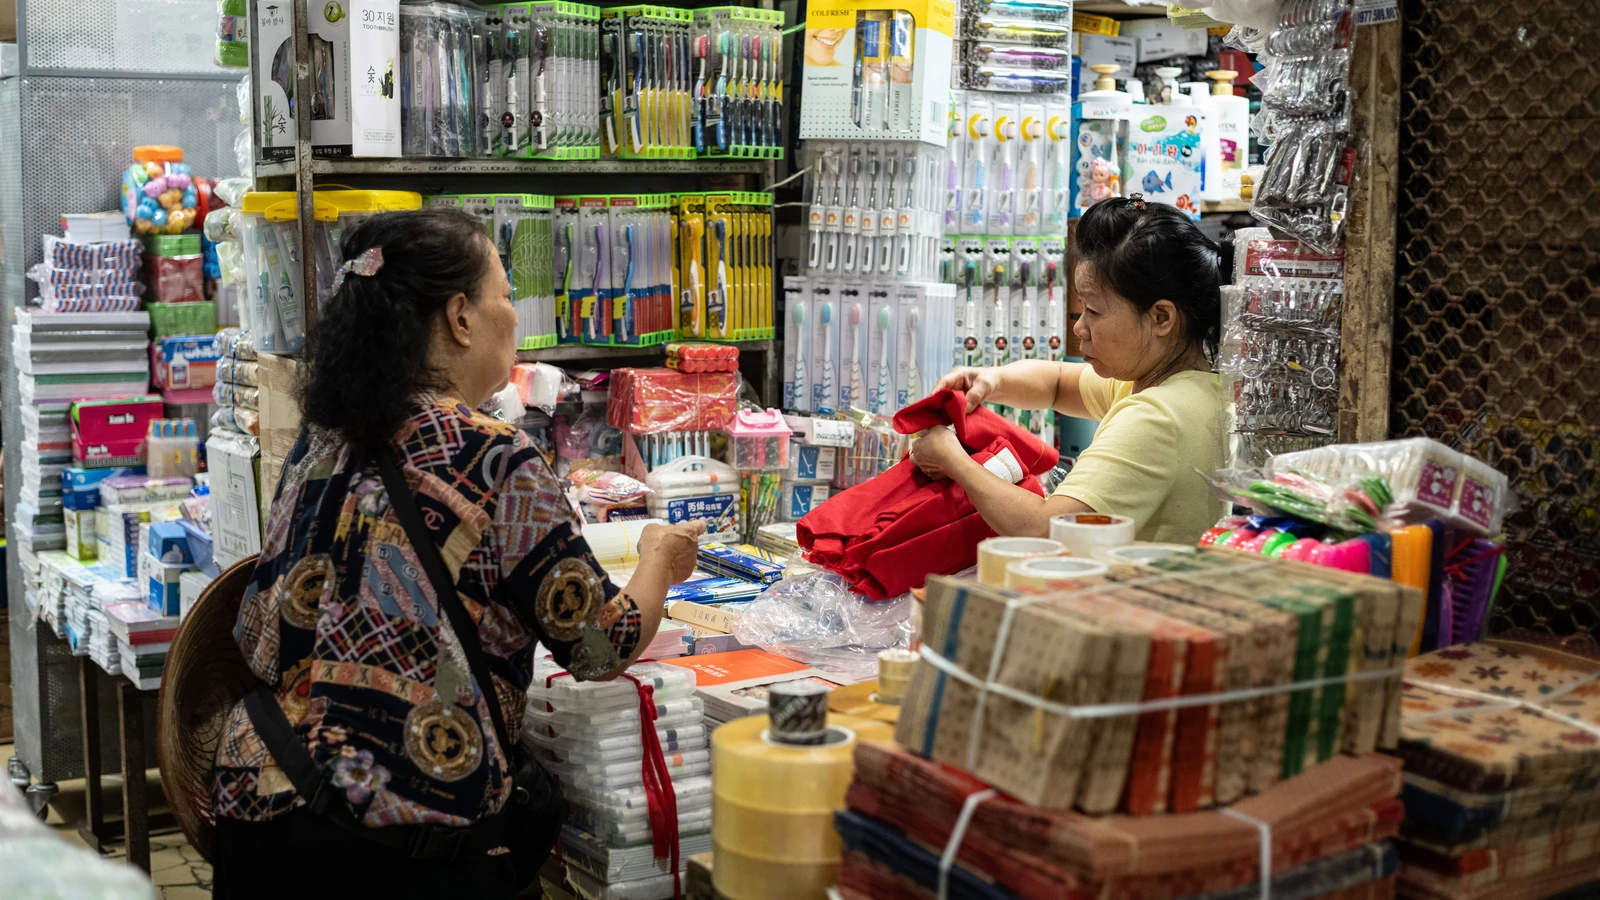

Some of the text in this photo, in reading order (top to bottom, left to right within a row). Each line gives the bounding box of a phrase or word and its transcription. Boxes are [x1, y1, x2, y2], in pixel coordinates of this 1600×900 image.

[362, 9, 394, 25] 30 지원
[363, 24, 394, 32] TOOTHBRUSH
